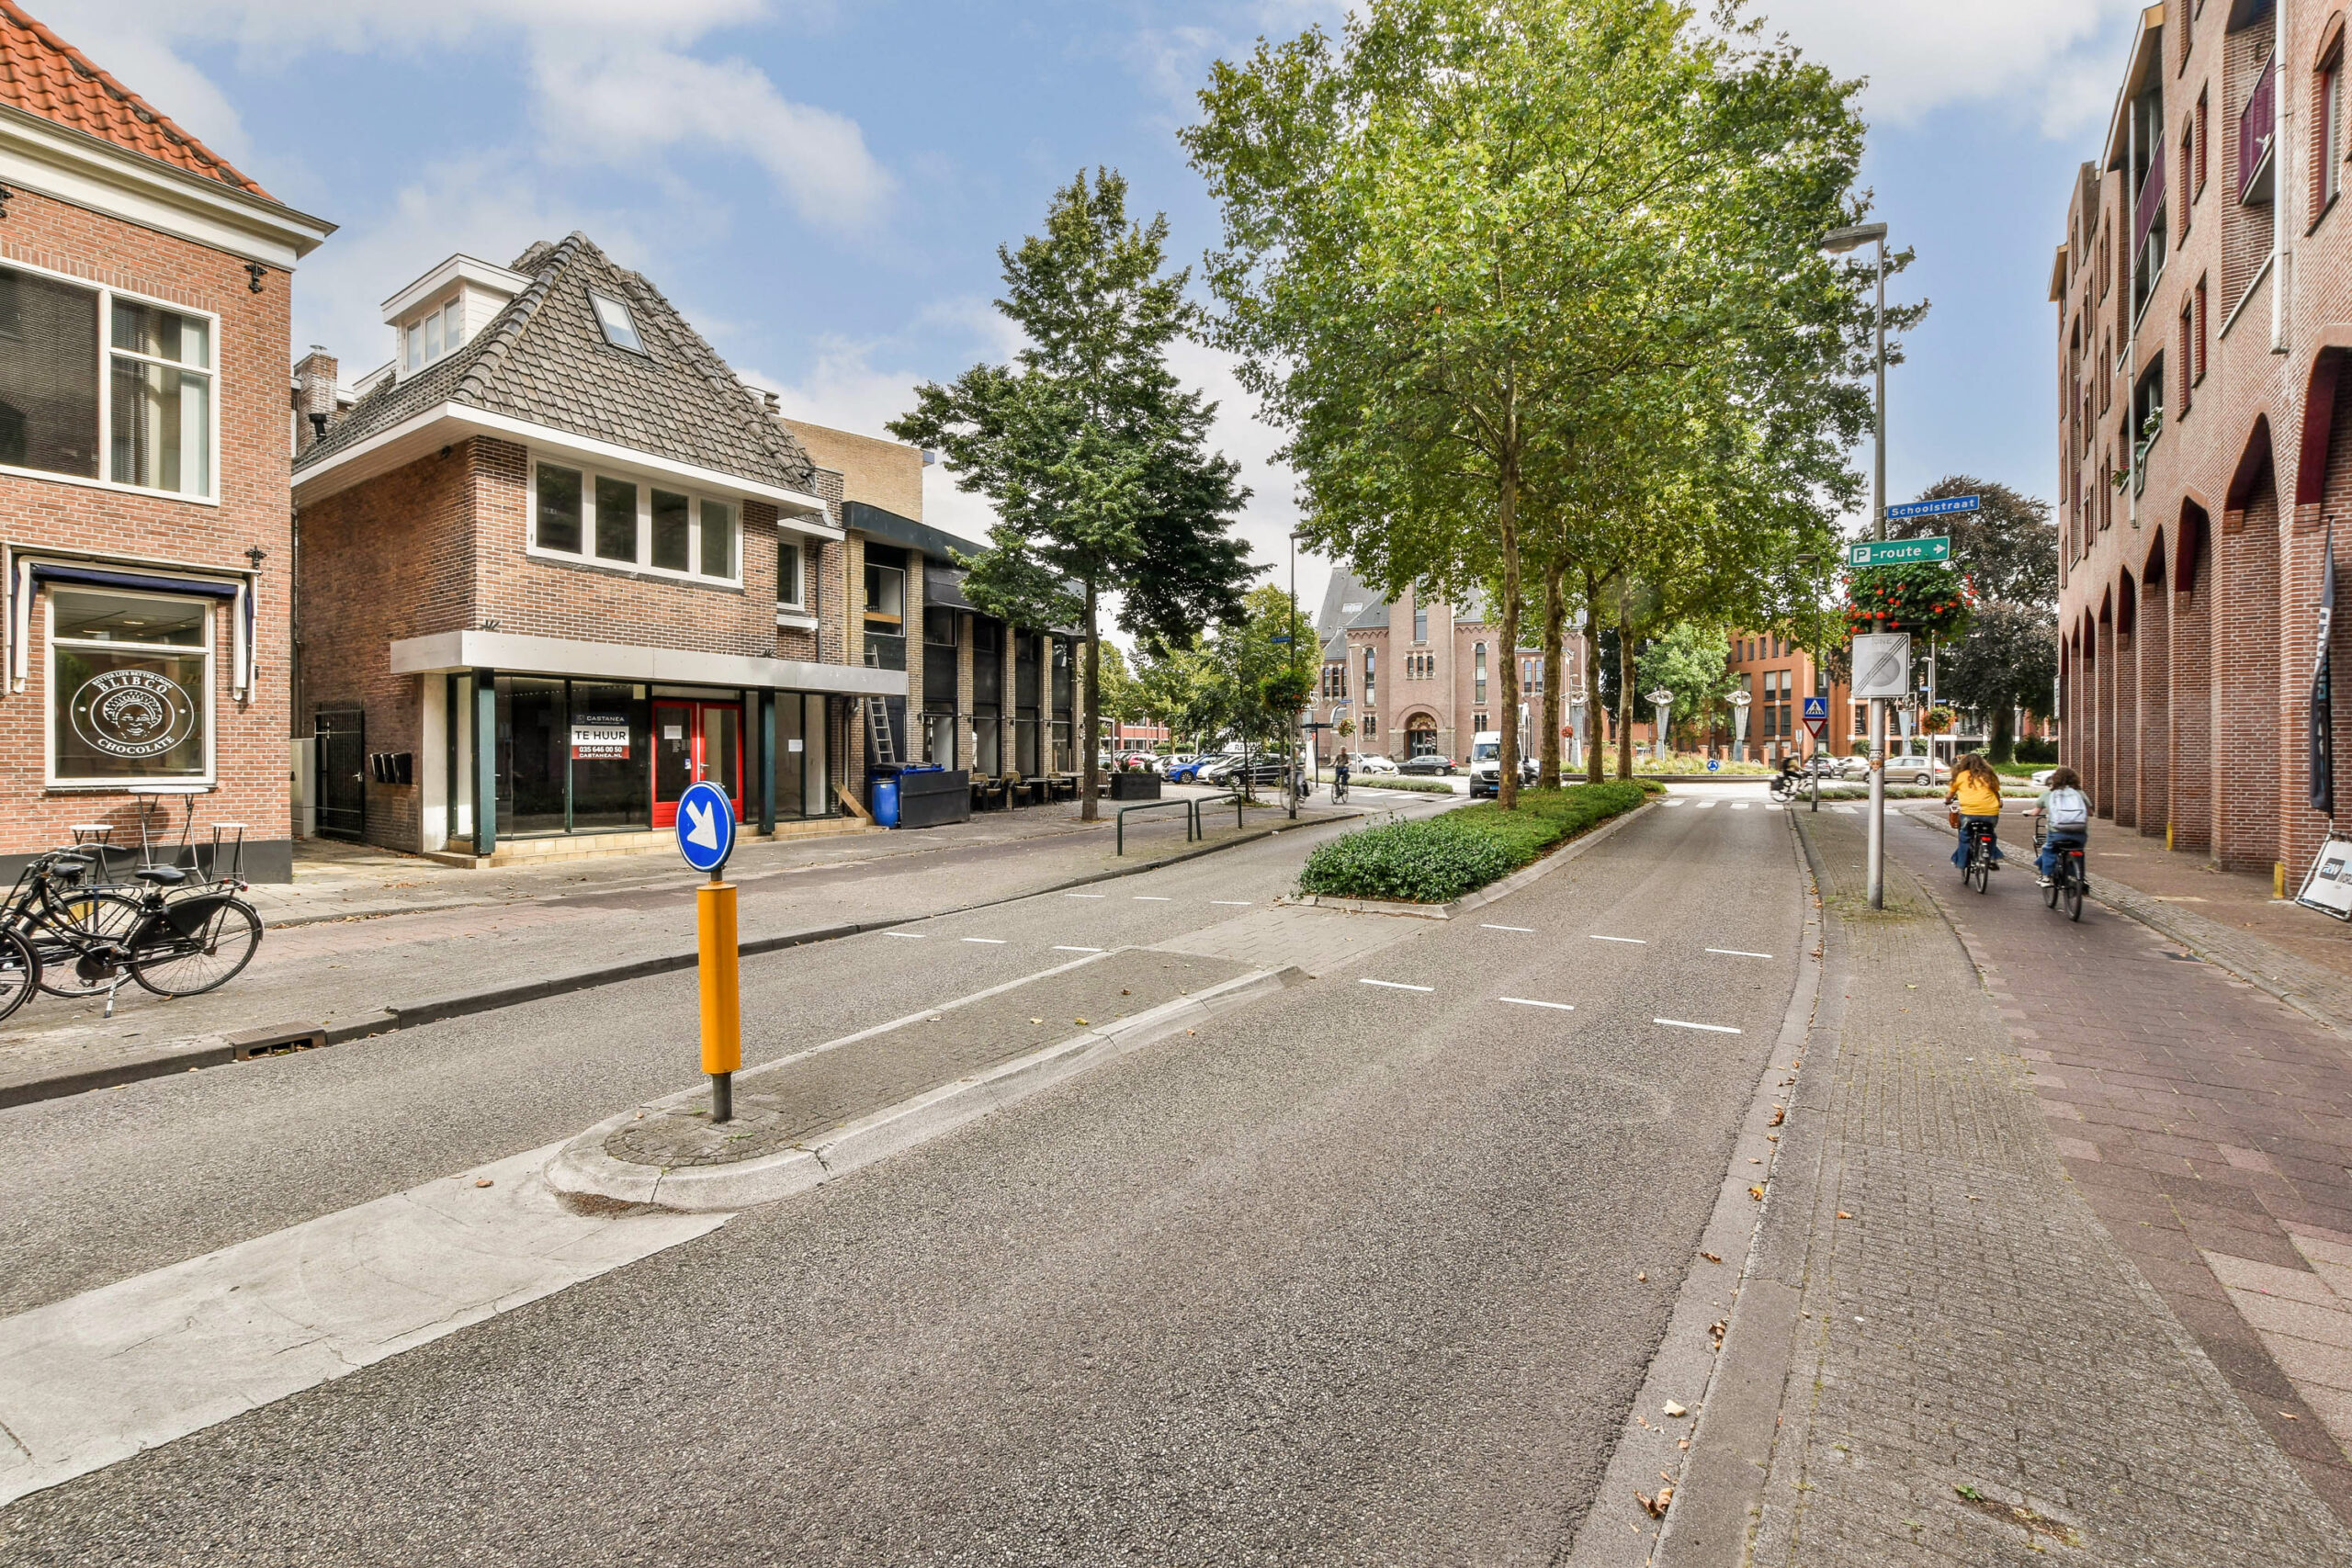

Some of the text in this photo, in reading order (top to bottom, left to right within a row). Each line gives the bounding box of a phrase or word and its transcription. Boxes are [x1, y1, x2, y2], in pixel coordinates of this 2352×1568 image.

[1891, 499, 1975, 516] Schoolstraat
[97, 676, 168, 693] BLIBCO
[575, 730, 627, 740] TE HUUR
[97, 735, 175, 754] CHOCOLATE
